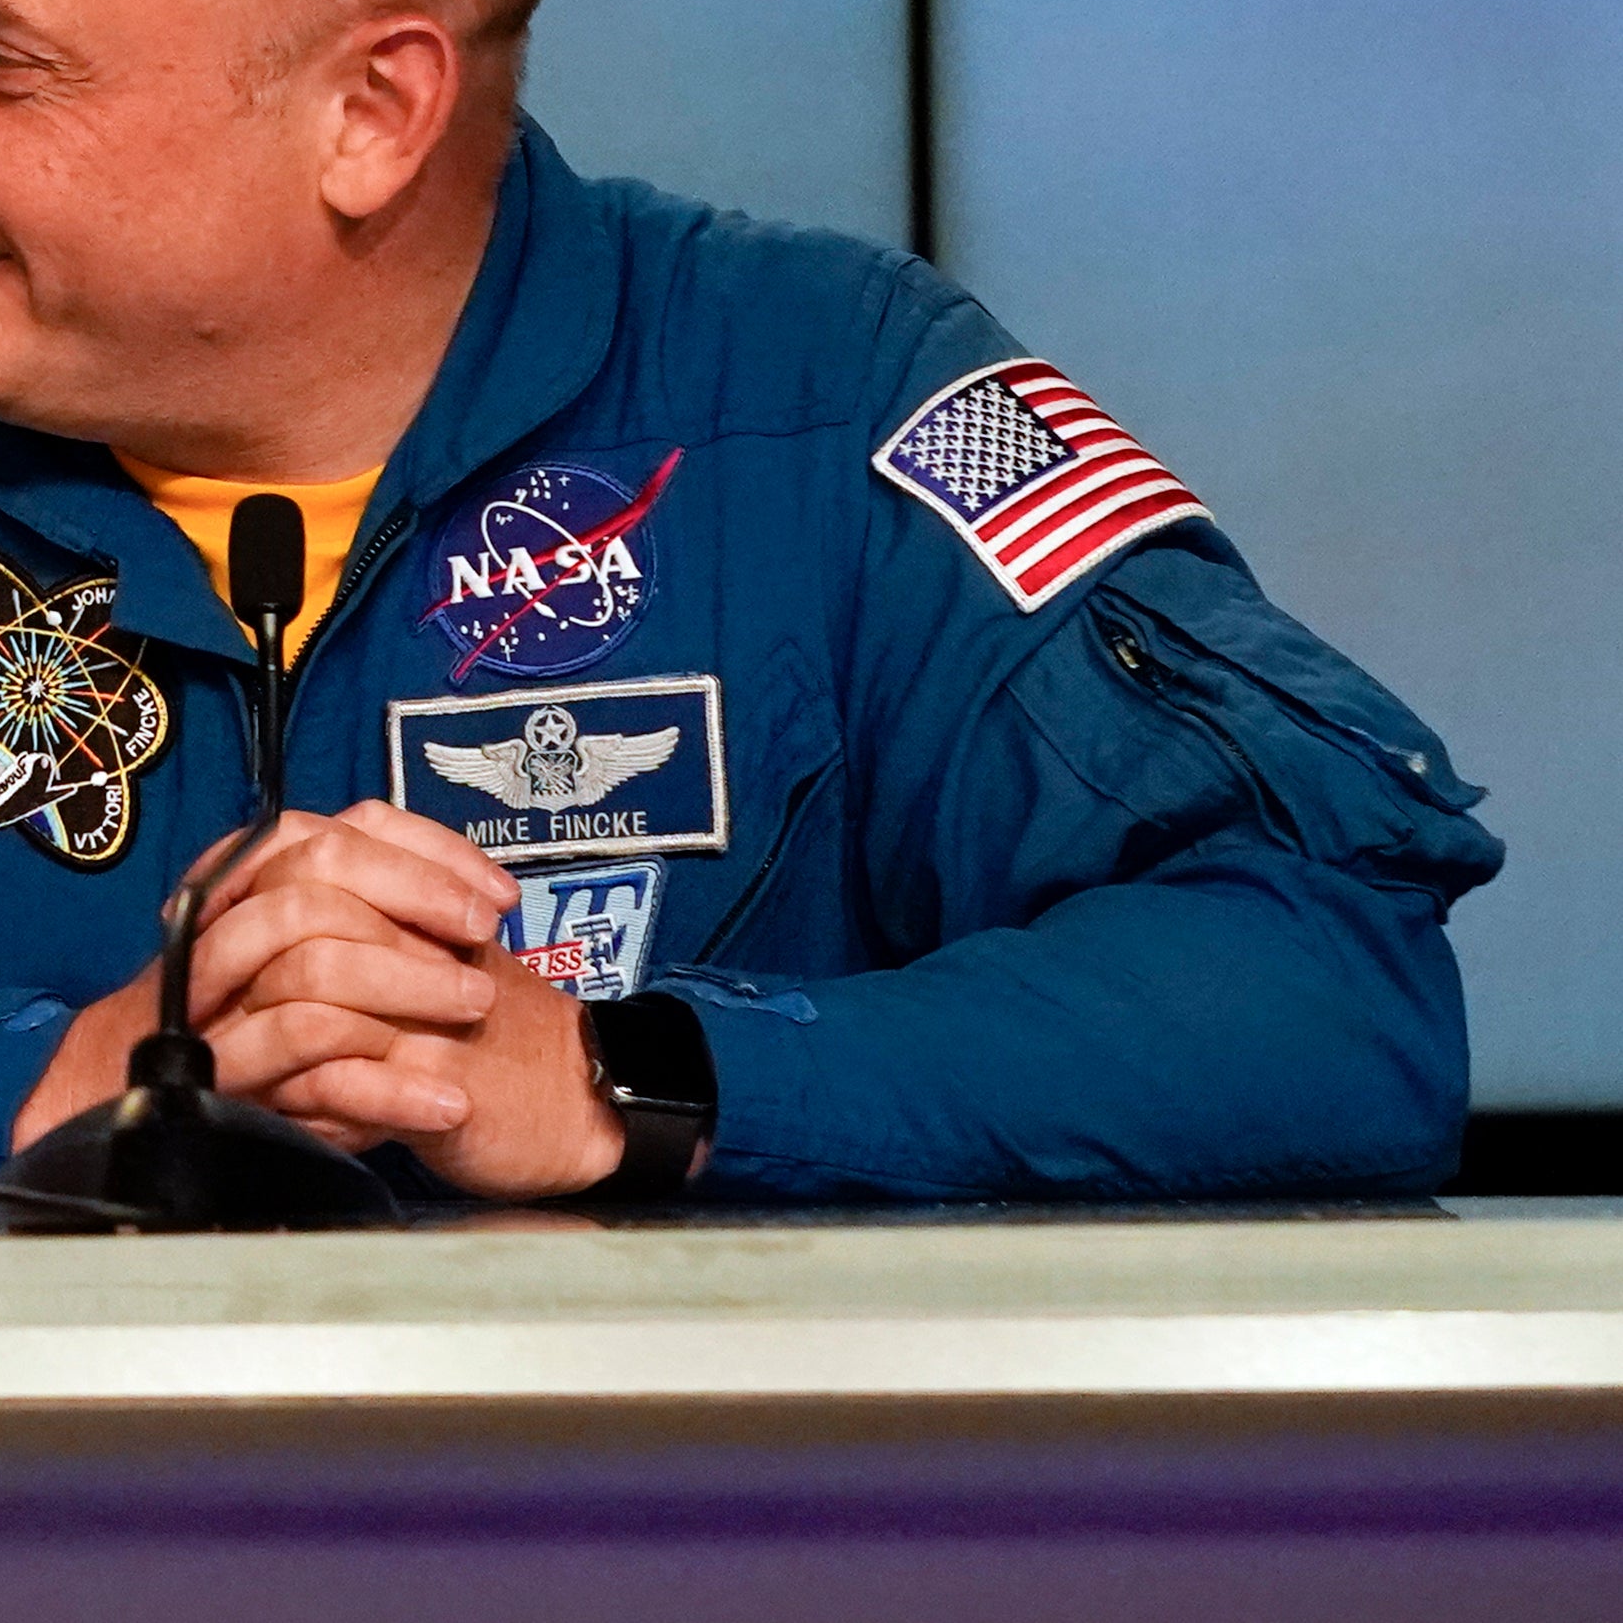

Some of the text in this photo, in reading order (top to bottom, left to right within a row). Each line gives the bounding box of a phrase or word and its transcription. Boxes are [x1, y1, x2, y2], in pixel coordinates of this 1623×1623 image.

[447, 536, 644, 604] NASA
[125, 687, 158, 758] FINCKE
[74, 784, 123, 850] VITTORI
[465, 811, 648, 846] MIKE FINCKE
[547, 948, 583, 974] ISS
